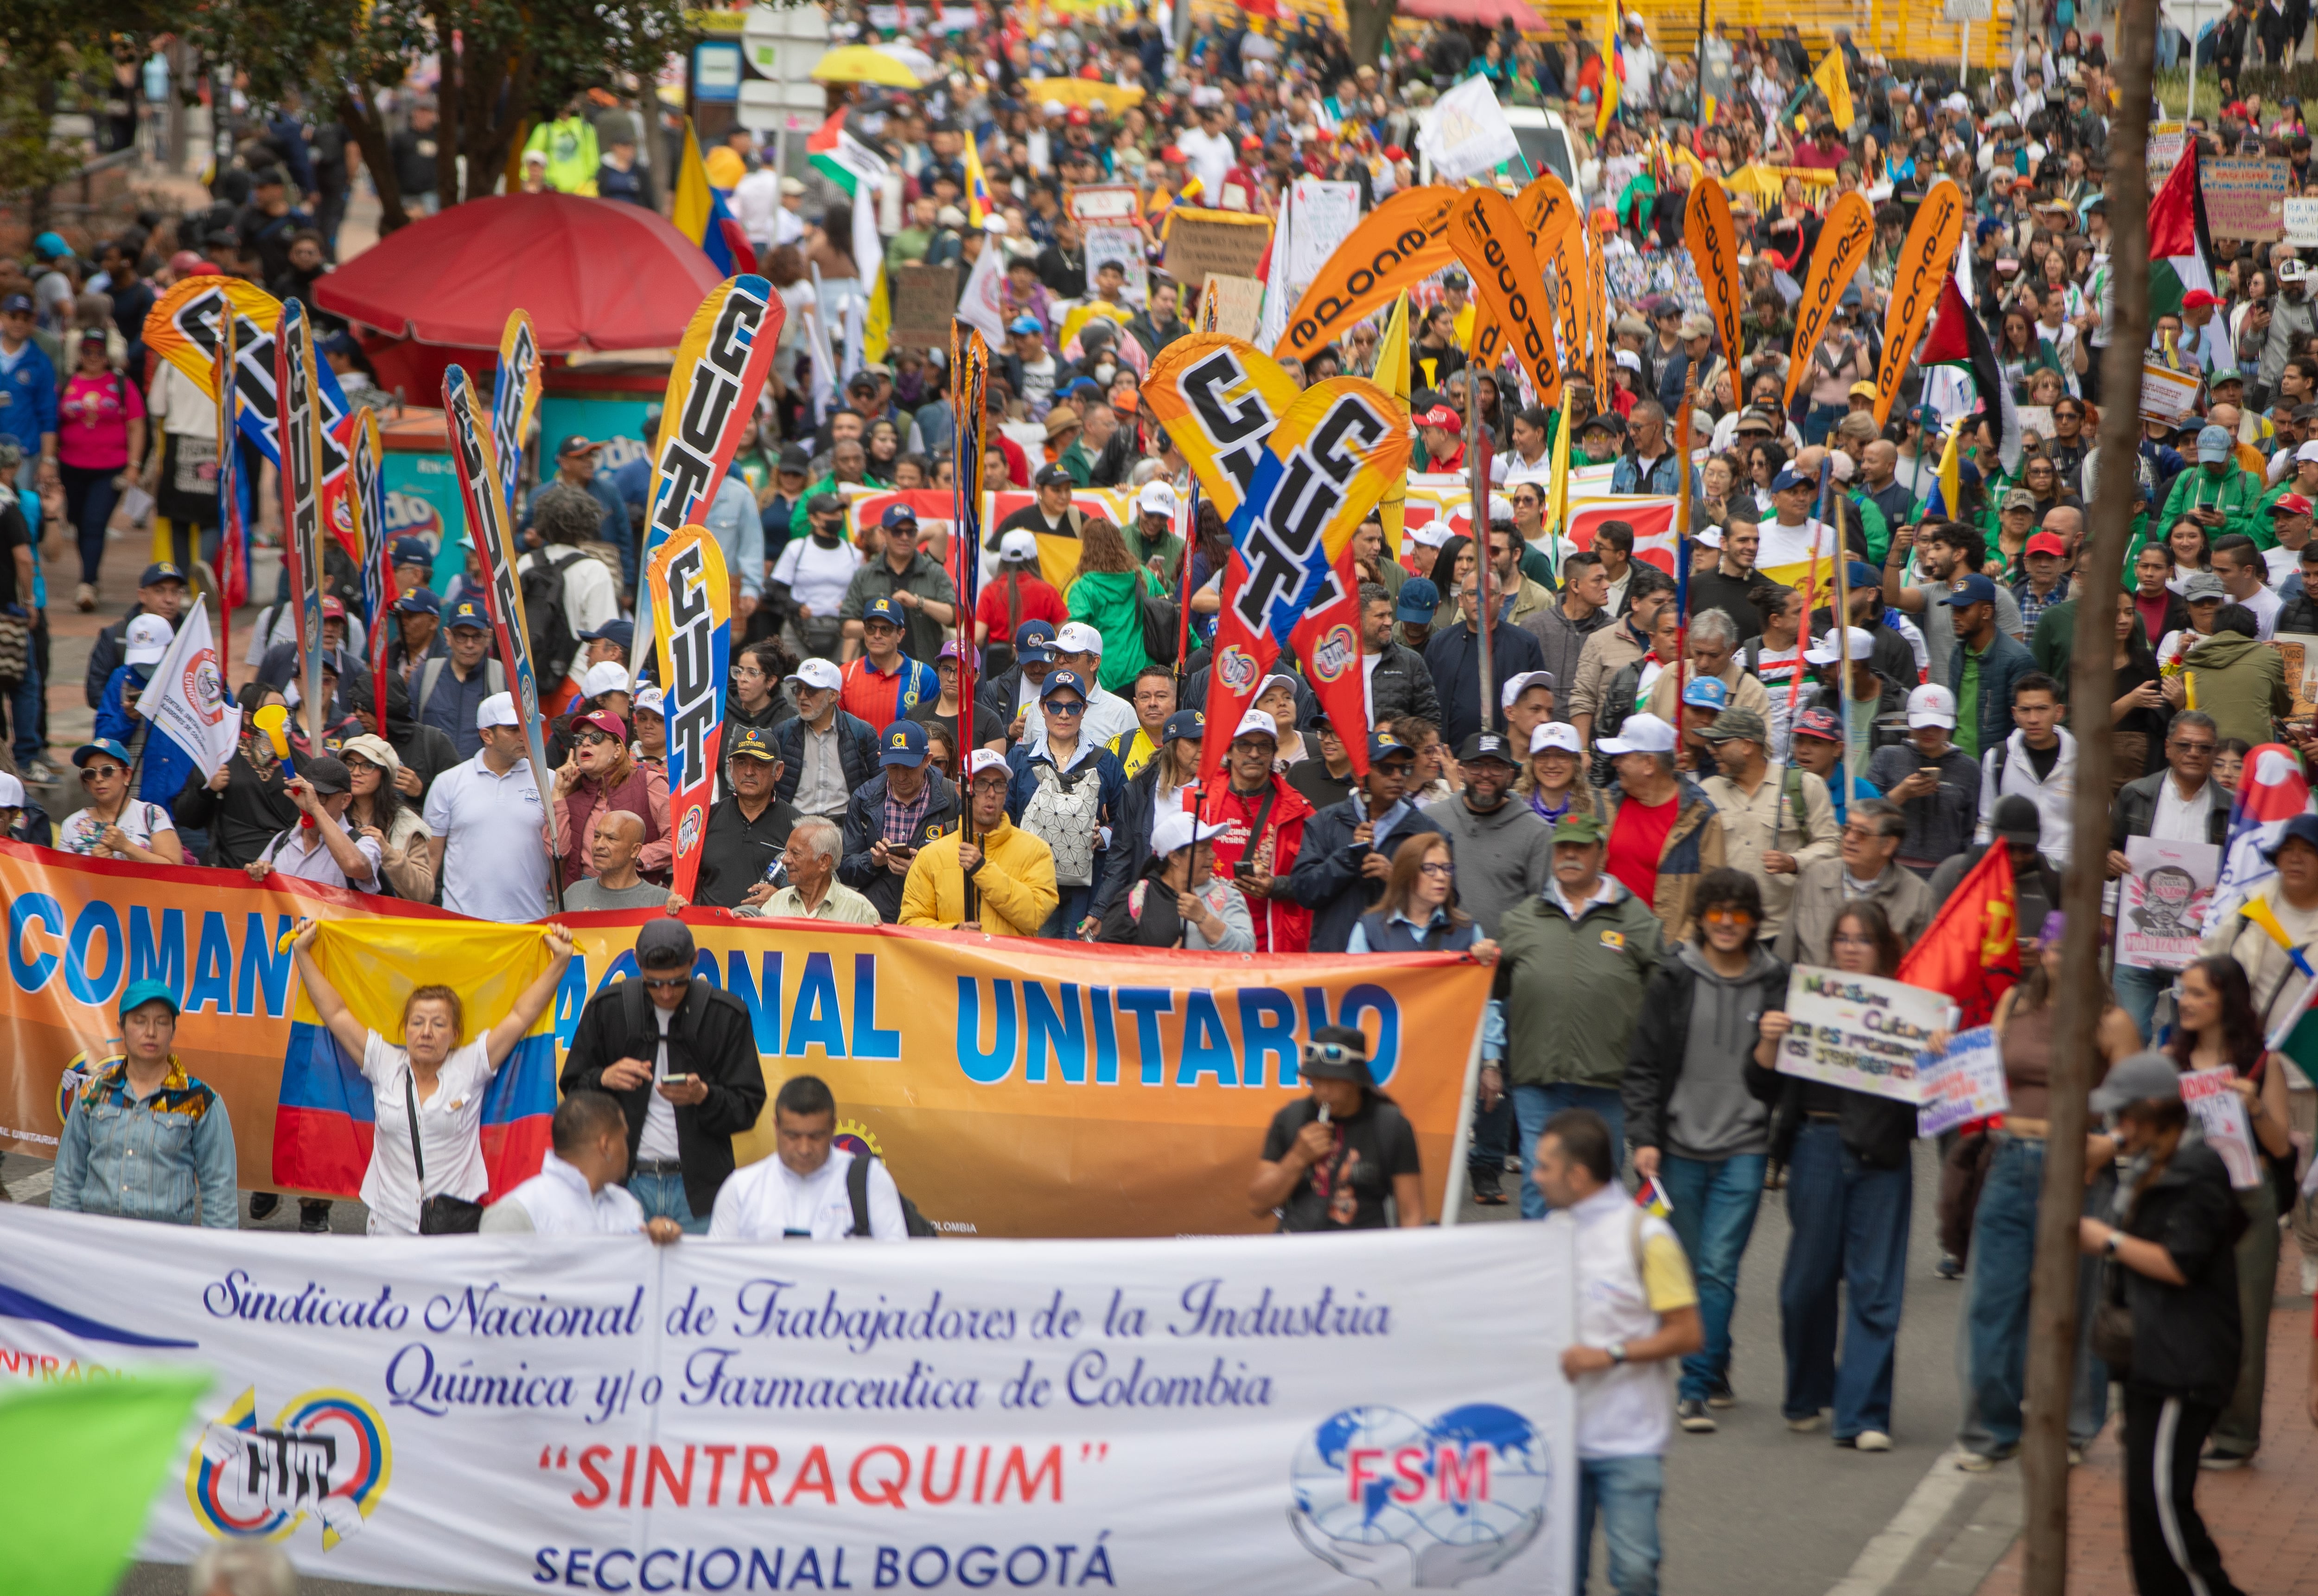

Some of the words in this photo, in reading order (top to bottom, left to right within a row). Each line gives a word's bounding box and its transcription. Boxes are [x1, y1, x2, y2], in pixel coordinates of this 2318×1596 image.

[1473, 197, 1554, 388] fecode
[1700, 187, 1738, 370] fecode
[1798, 219, 1867, 361] fecode
[1880, 202, 1955, 398] fecode
[284, 318, 317, 601] CUT
[651, 287, 770, 535] CUT
[451, 381, 526, 668] CUT
[1232, 392, 1392, 640] CUT
[161, 704, 185, 726] AJADORES
[163, 695, 184, 714] CENTRAL
[665, 538, 717, 796] CUT
[8, 891, 297, 1020] COMAN
[957, 976, 1402, 1088] UNITARIO
[12, 1129, 59, 1146] UNITARIA
[929, 1220, 977, 1234] OLOMBIA
[203, 1268, 409, 1331] Sindicato
[424, 1282, 644, 1337] Nacional
[666, 1285, 716, 1336] de
[732, 1278, 1016, 1354] Trabajadores
[1030, 1288, 1082, 1340] de
[1103, 1288, 1148, 1339] la
[1166, 1278, 1391, 1339] Industria
[386, 1342, 578, 1417] Química
[680, 1347, 983, 1410] Farmaceutica
[1000, 1359, 1052, 1409] de
[1065, 1348, 1276, 1408] Colombia
[239, 1429, 337, 1513] CUT
[1347, 1446, 1491, 1503] FSM
[533, 1546, 852, 1593] SECCIONAL
[874, 1532, 1117, 1591] BOGOTÁ
